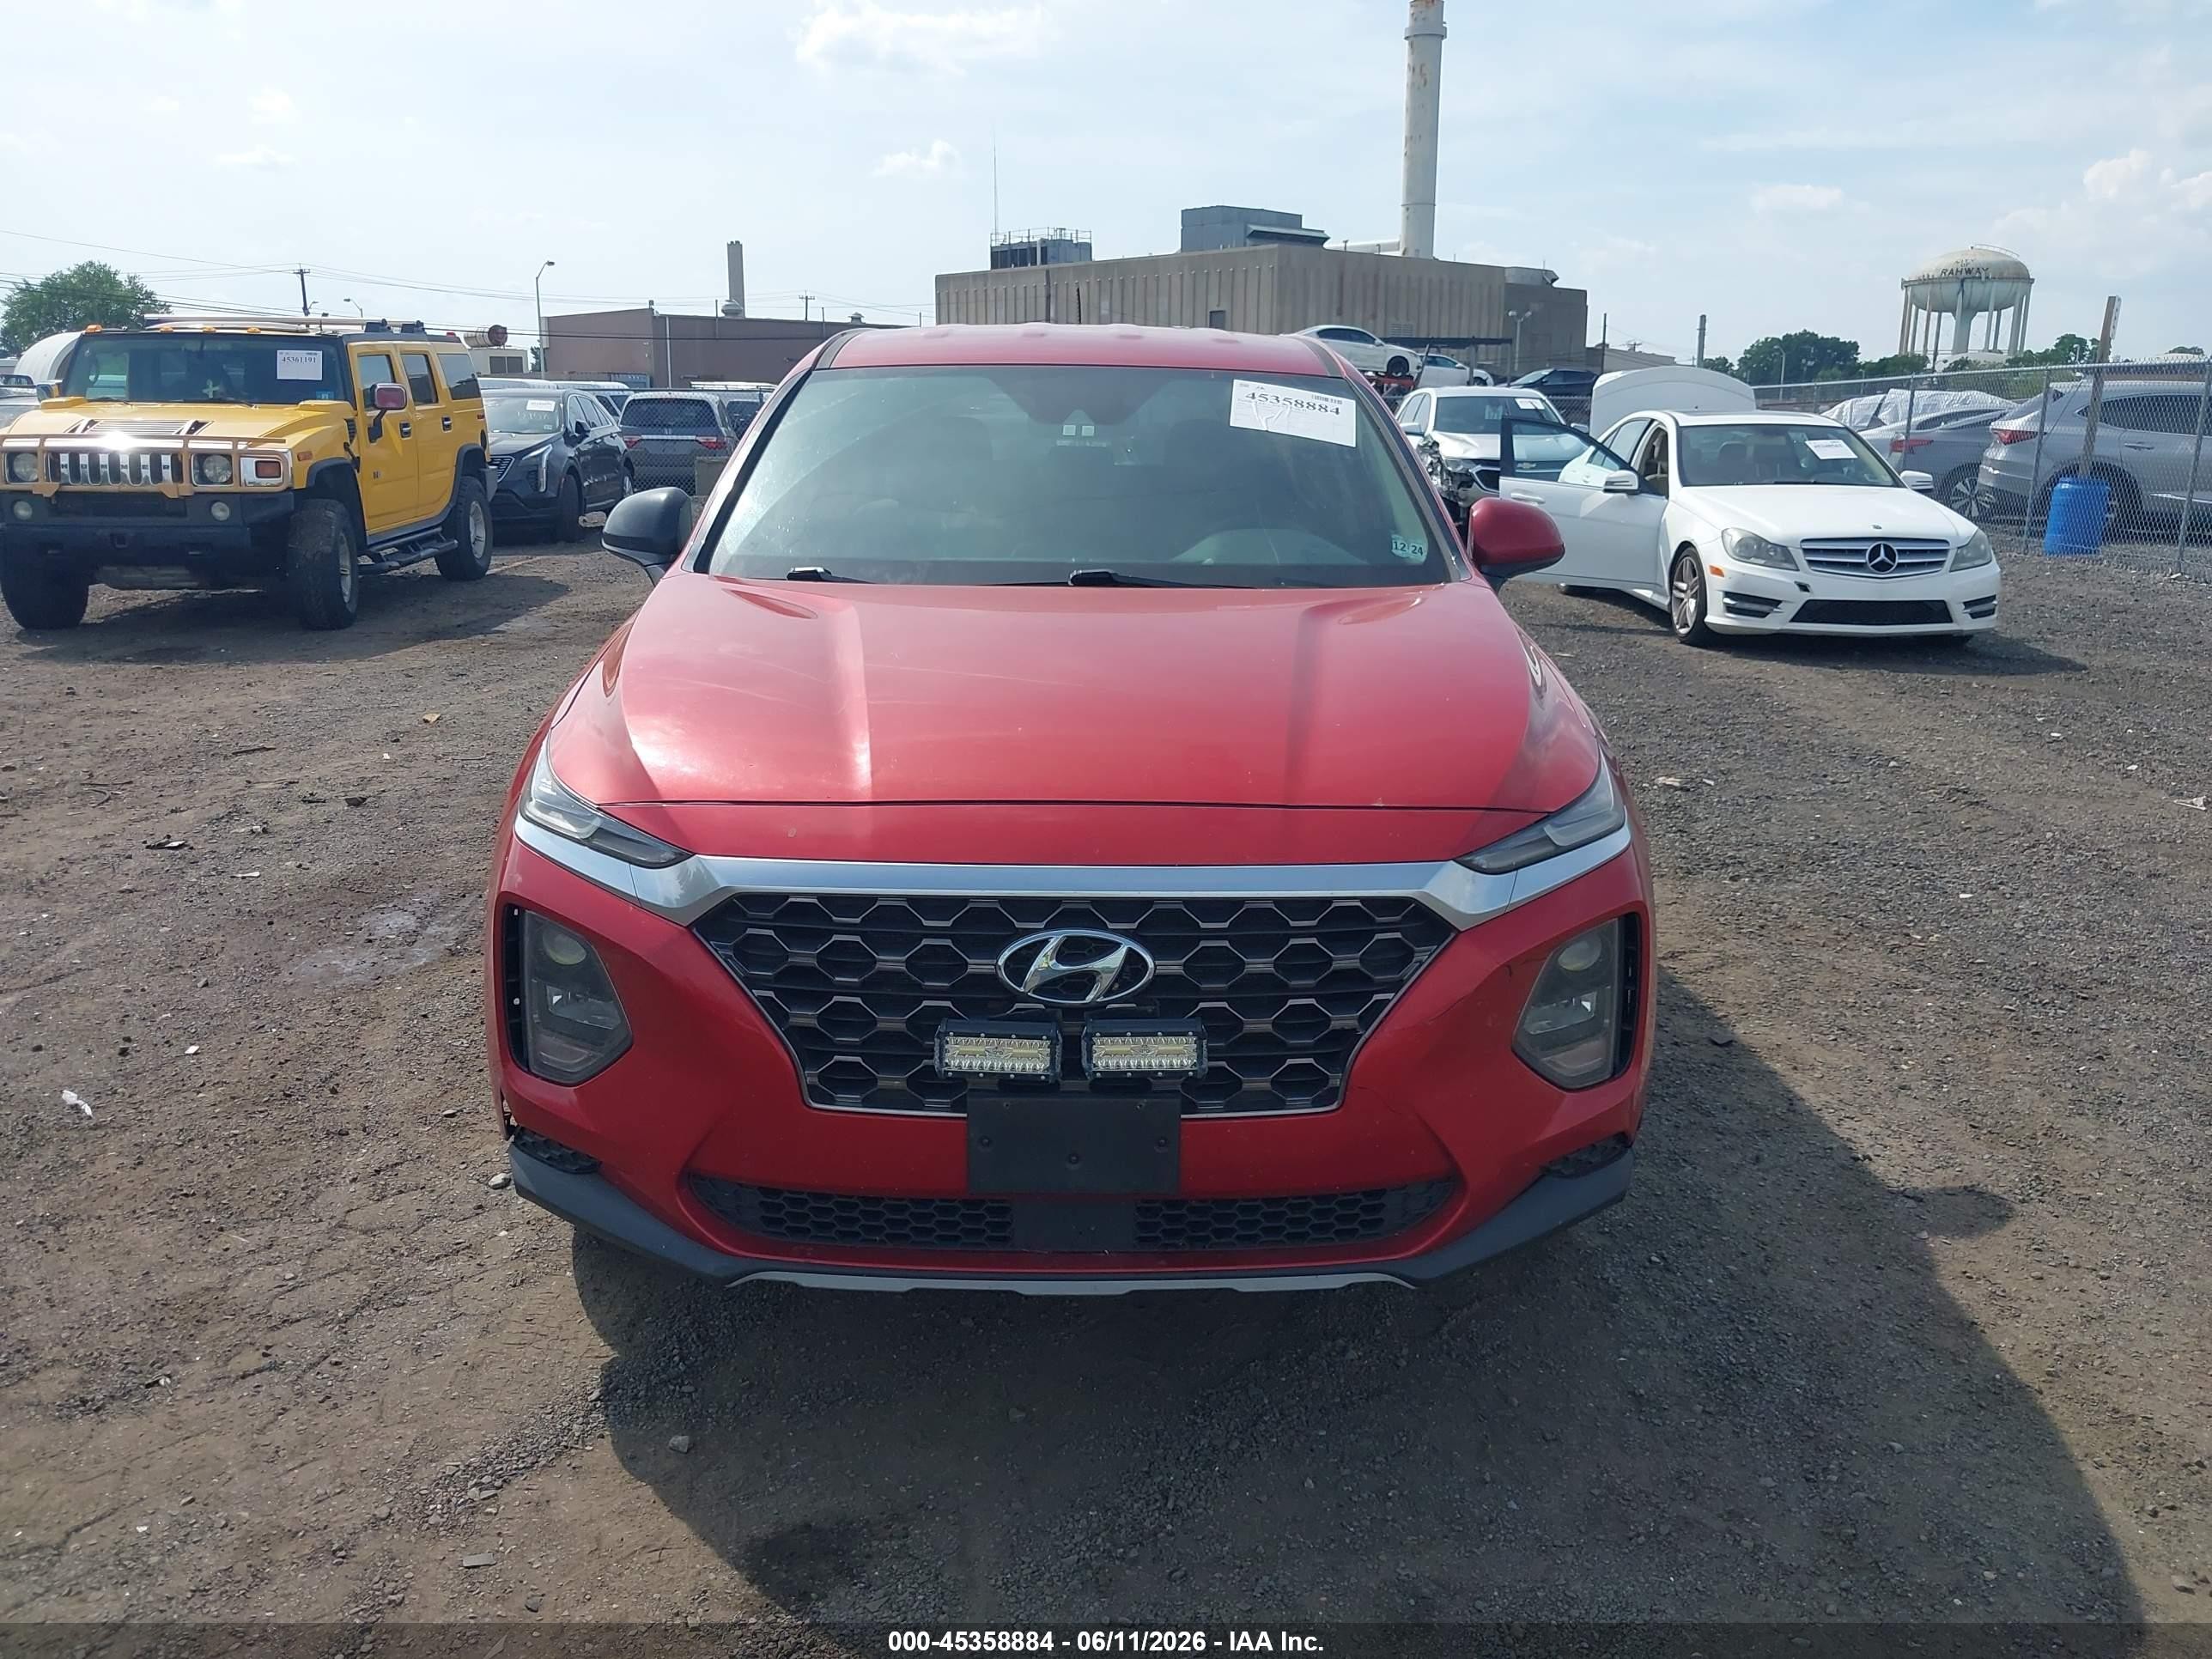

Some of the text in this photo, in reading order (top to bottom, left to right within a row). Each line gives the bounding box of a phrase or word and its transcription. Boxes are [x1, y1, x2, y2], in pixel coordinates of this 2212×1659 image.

[1940, 267, 1989, 276] RAHWAY
[1245, 392, 1340, 416] 45358884
[1394, 541, 1423, 556] 12 24
